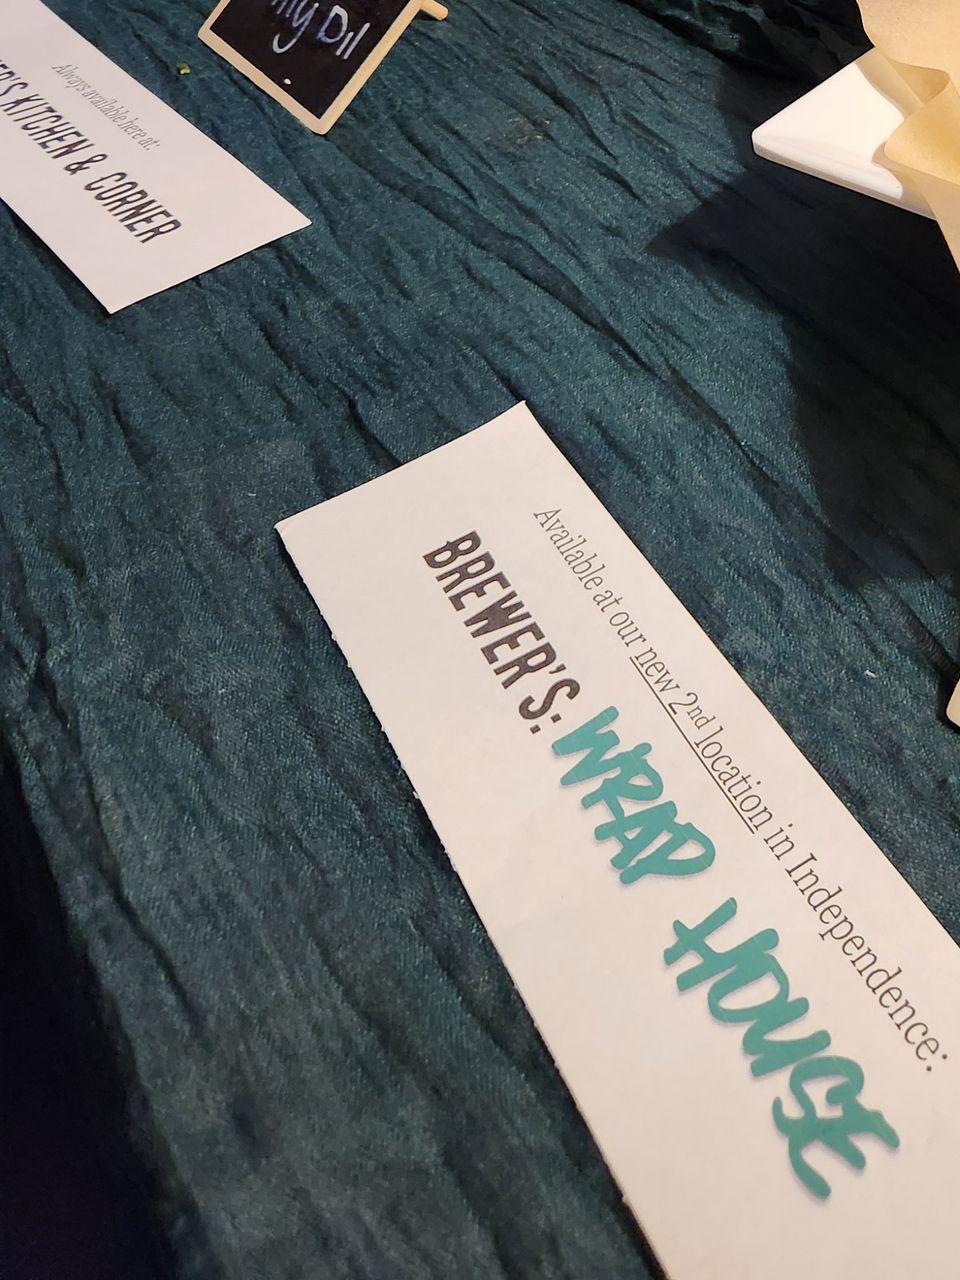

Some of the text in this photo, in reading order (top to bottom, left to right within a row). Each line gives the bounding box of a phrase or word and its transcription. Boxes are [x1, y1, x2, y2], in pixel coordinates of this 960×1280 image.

[0, 93, 182, 244] KITCHEN & CORNER
[51, 63, 91, 92] Always
[81, 88, 129, 123] available
[117, 117, 147, 140] here
[422, 530, 901, 1198] BREWER'S: WRAP HOUSE
[533, 508, 948, 1073] Available at our new 2nd location in Independence:
